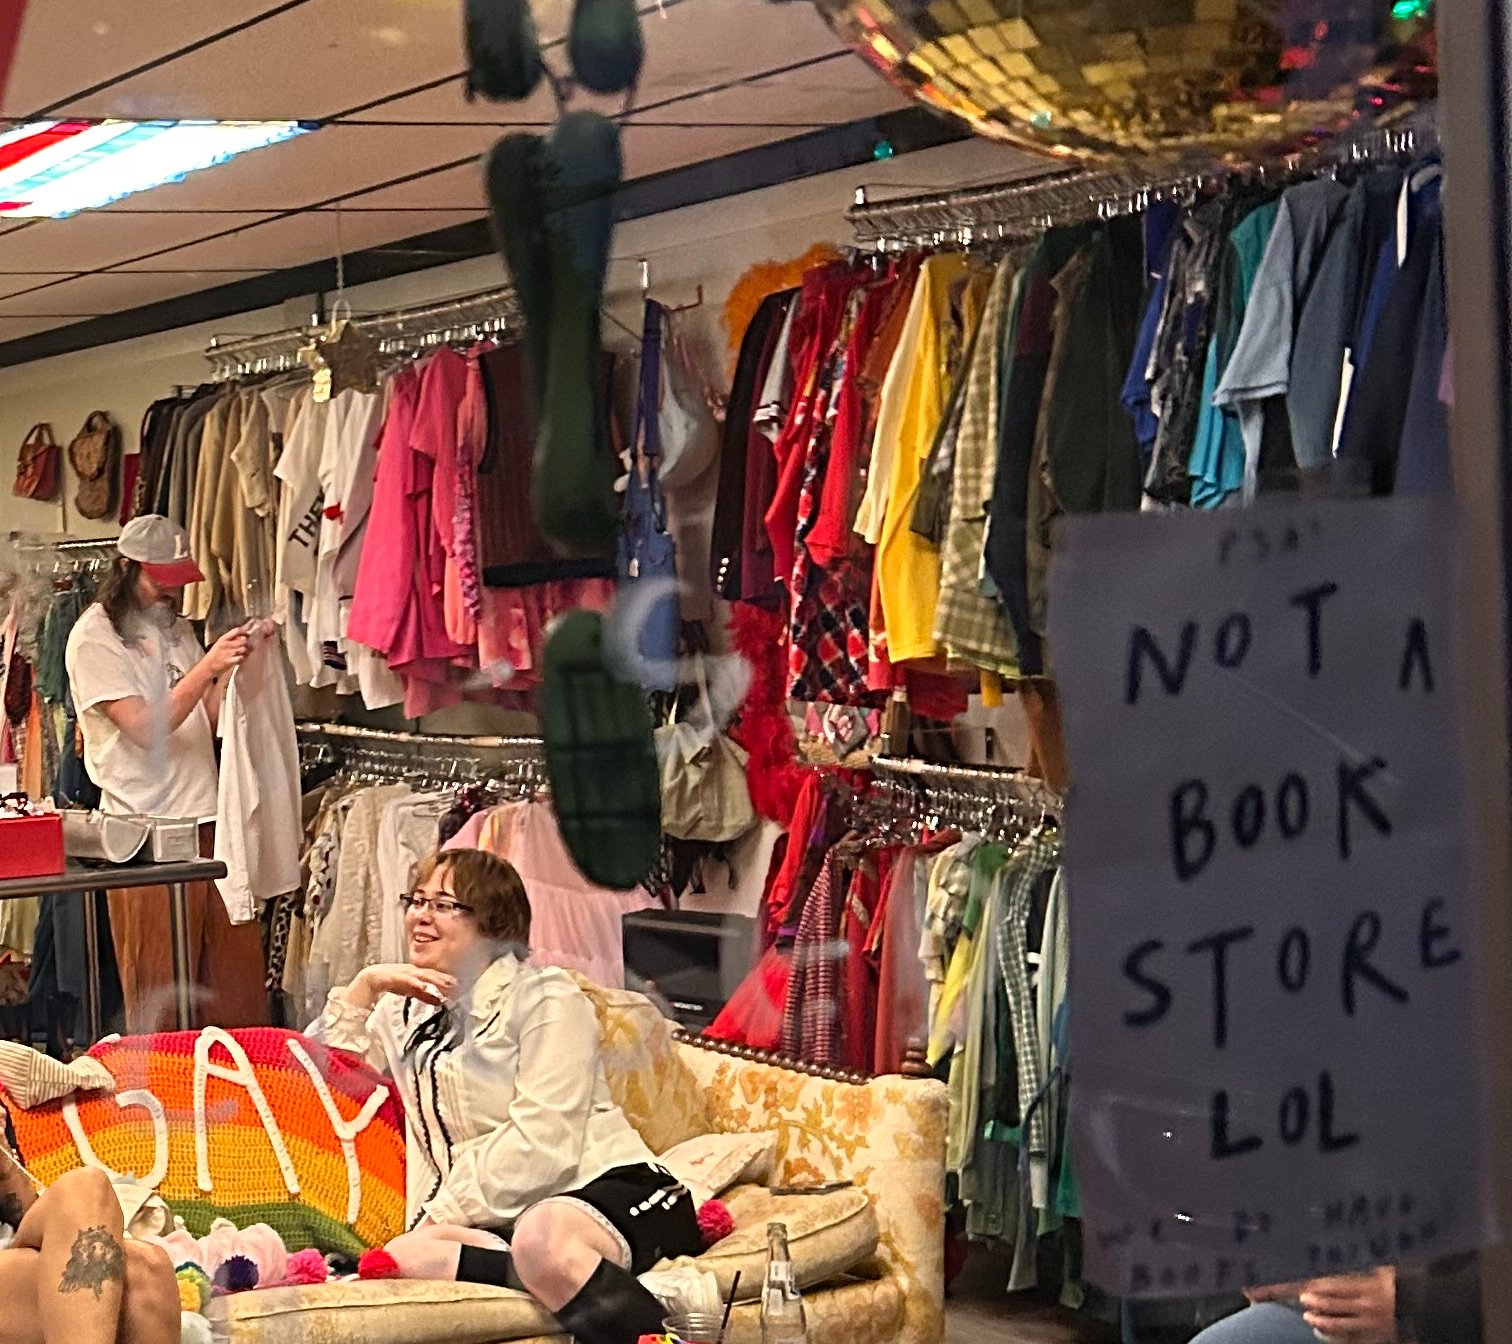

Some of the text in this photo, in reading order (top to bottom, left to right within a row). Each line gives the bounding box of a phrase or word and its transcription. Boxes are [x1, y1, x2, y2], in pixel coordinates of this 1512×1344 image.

[1124, 581, 1340, 706] NOT
[1170, 755, 1394, 880] BOOK
[1122, 897, 1462, 1048] STORE
[1209, 1070, 1361, 1159] LOL
